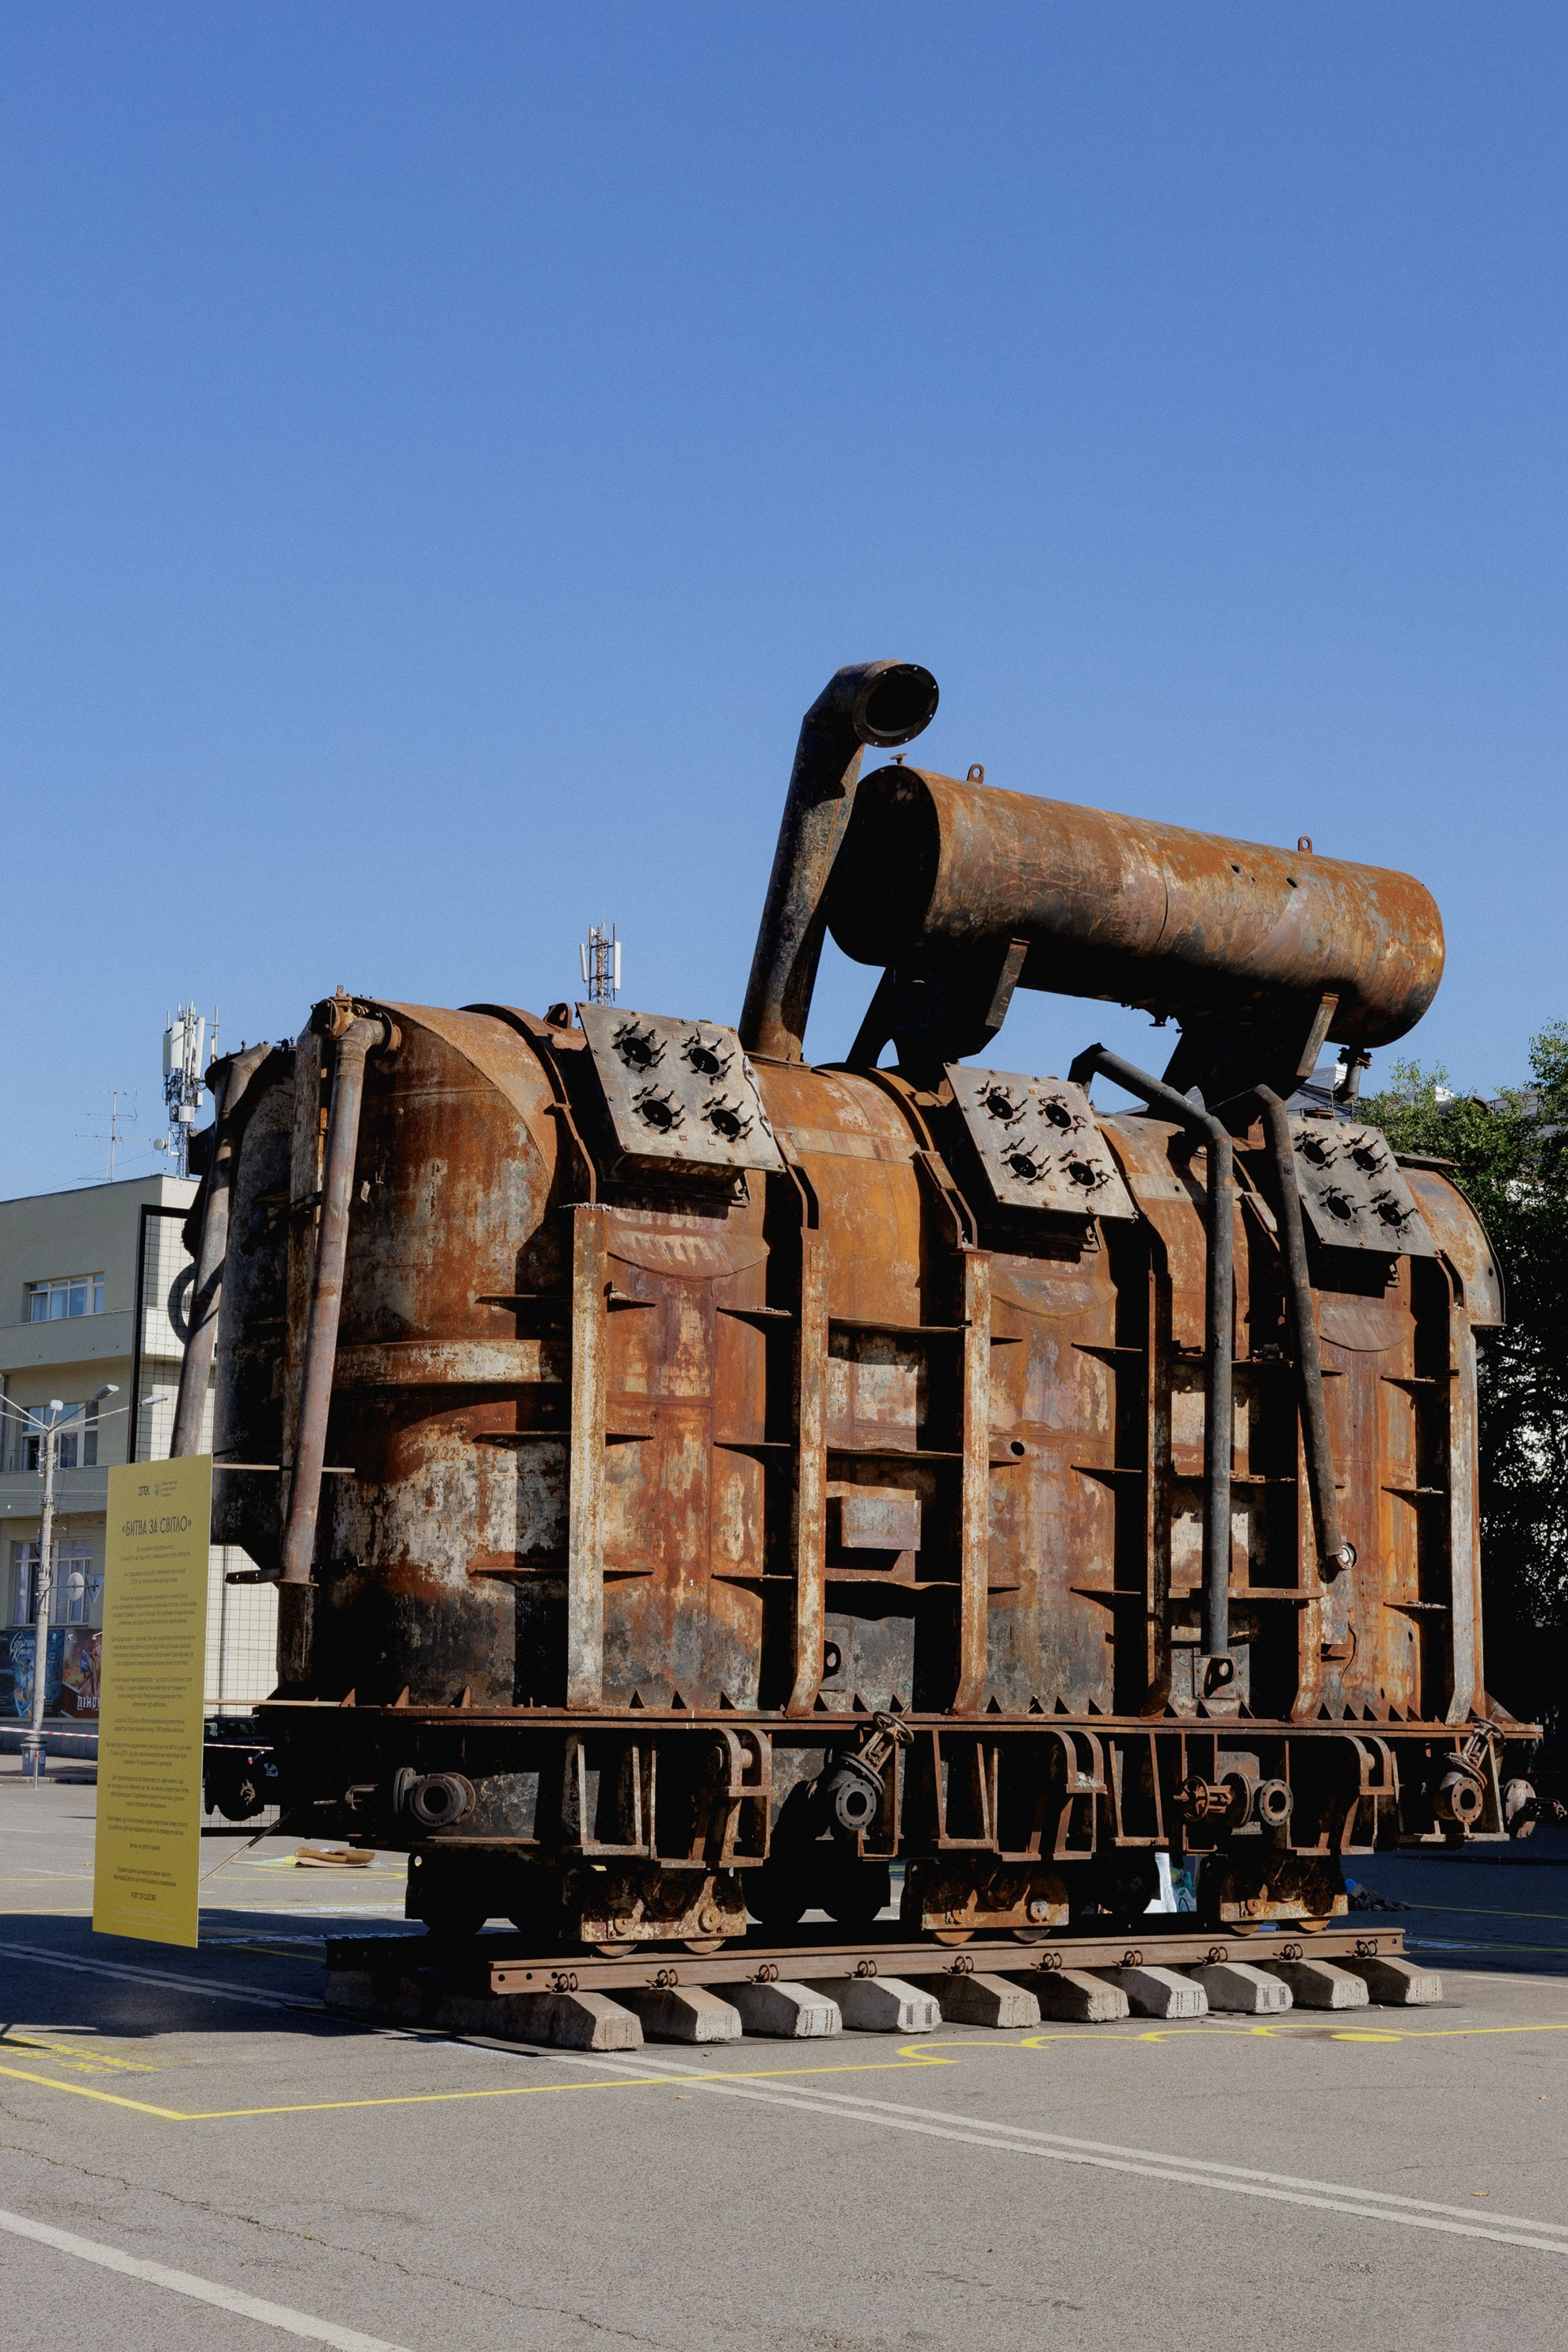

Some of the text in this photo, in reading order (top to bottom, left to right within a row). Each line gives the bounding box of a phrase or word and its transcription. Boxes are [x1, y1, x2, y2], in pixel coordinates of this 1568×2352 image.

[122, 1515, 192, 1536] «БИТВА ЗА СВІТЛО»
[10, 1631, 36, 1653] Сойчин
